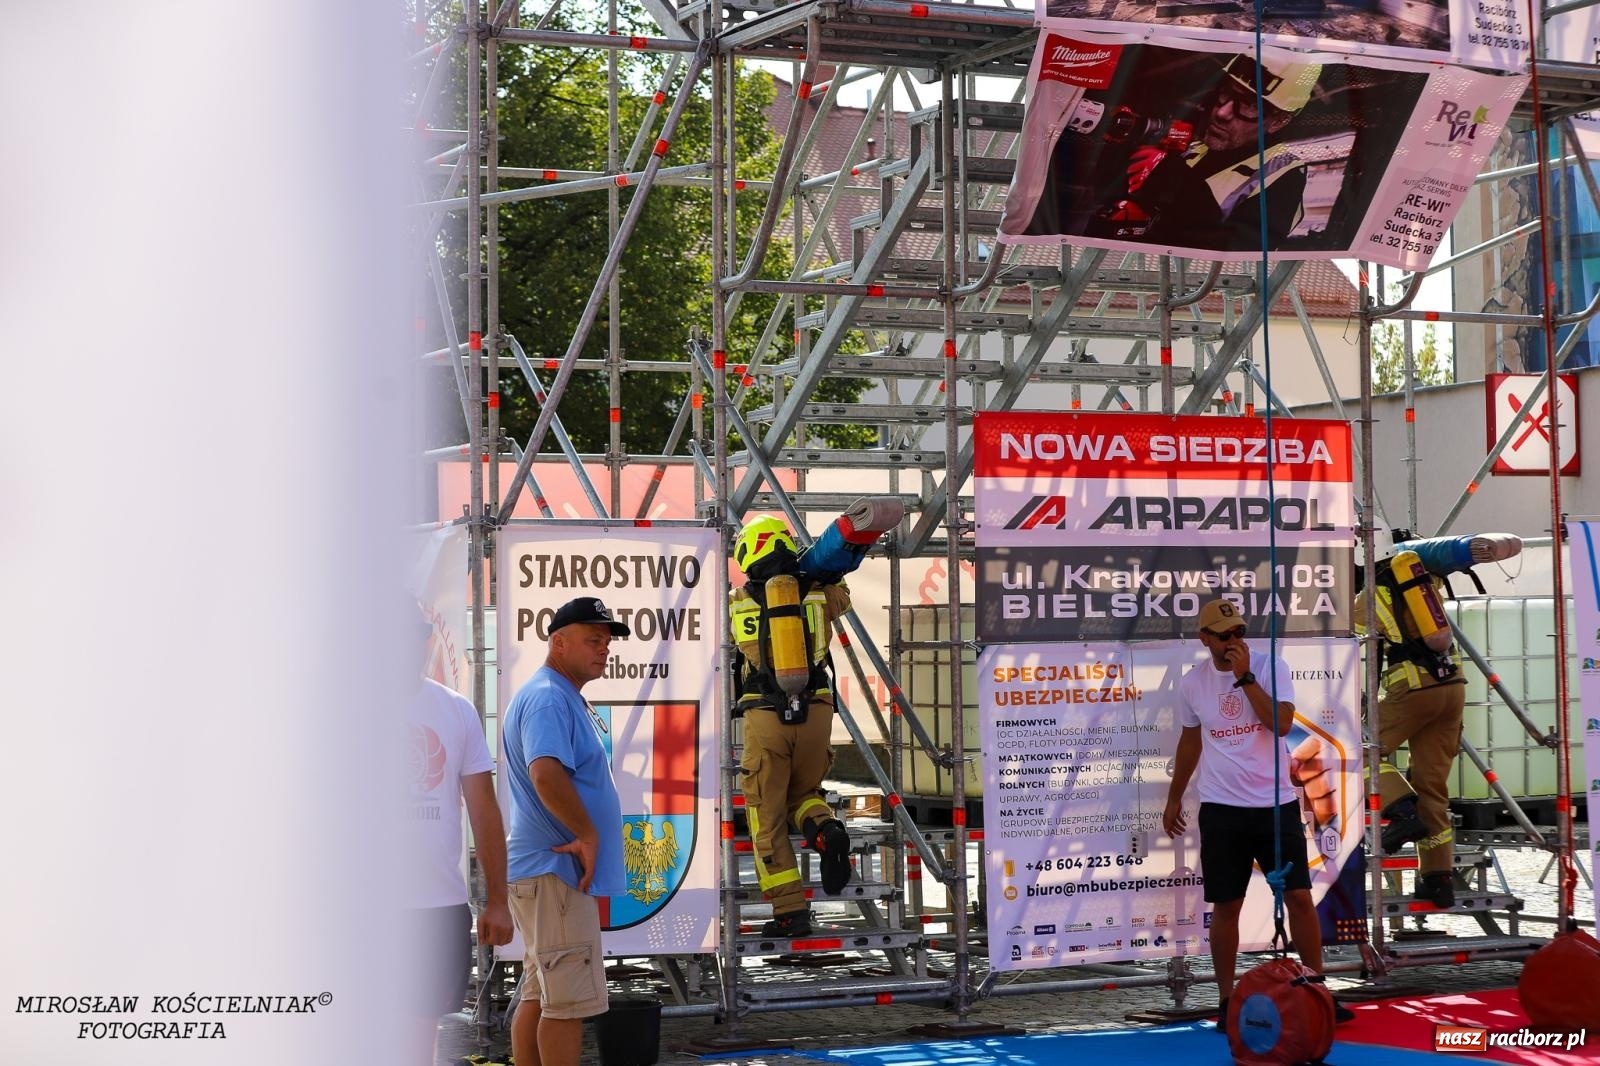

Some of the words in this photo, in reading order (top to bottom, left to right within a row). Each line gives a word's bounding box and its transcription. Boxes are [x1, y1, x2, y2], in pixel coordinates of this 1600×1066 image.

[1479, 2, 1517, 19] Racibórz
[1475, 17, 1513, 34] Sudecka
[1515, 24, 1522, 35] 3
[1481, 35, 1492, 46] 32
[1494, 37, 1509, 49] 755
[1510, 39, 1520, 50] 18
[1052, 45, 1112, 62] Milwaukee
[1436, 100, 1471, 126] Re
[1394, 208, 1444, 228] Racibórz
[1384, 220, 1432, 240] Sudecka
[1434, 232, 1443, 242] 3
[1386, 236, 1400, 248] 32
[1402, 239, 1421, 253] 755
[1423, 245, 1434, 255] 18
[1000, 433, 1135, 461] NOWA
[1150, 435, 1334, 465] SIEDZIBA
[1088, 496, 1335, 531] ARPAPOL
[519, 554, 700, 588] STAROSTWO
[1002, 565, 1045, 590] ul.
[1064, 564, 1256, 589] Krakowska
[1274, 564, 1336, 589] 103
[1003, 594, 1200, 619] BIELSKO
[1221, 592, 1337, 617] BIAŁA
[517, 608, 700, 642] POTOWE
[602, 655, 669, 680] ciborzu
[993, 661, 1124, 683] SPECJALIŚCI
[1291, 670, 1343, 681] IECZENIA
[995, 683, 1143, 707] UBEZPIECZEŃ:
[996, 718, 1057, 728] FIRMOWYCH
[1088, 726, 1119, 736] MIENIE,
[1121, 724, 1160, 734] BUDYNKI,
[1210, 722, 1264, 739] Racibórz
[997, 741, 1027, 750] OCPD,
[1029, 739, 1057, 748] FLOTY
[998, 752, 1073, 764] MAJĄTKOWYCH
[998, 765, 1091, 777] KOMUNIKACYJNYCH
[999, 780, 1045, 790] ROLNYCH
[1093, 778, 1104, 786] OC
[1107, 776, 1146, 785] ROLNIKA,
[999, 794, 1042, 804] UPRAWY,
[1000, 809, 1014, 817] NA
[1016, 807, 1045, 816] ŻYCIE
[1055, 814, 1120, 826] UBEZPIECZENIA
[1001, 829, 1073, 839] INDYWIDUALNE,
[1074, 826, 1105, 836] OPIEKA
[1026, 860, 1052, 872] +48
[1056, 858, 1083, 870] 604
[1087, 856, 1112, 868] 223
[1130, 938, 1148, 947] HDI
